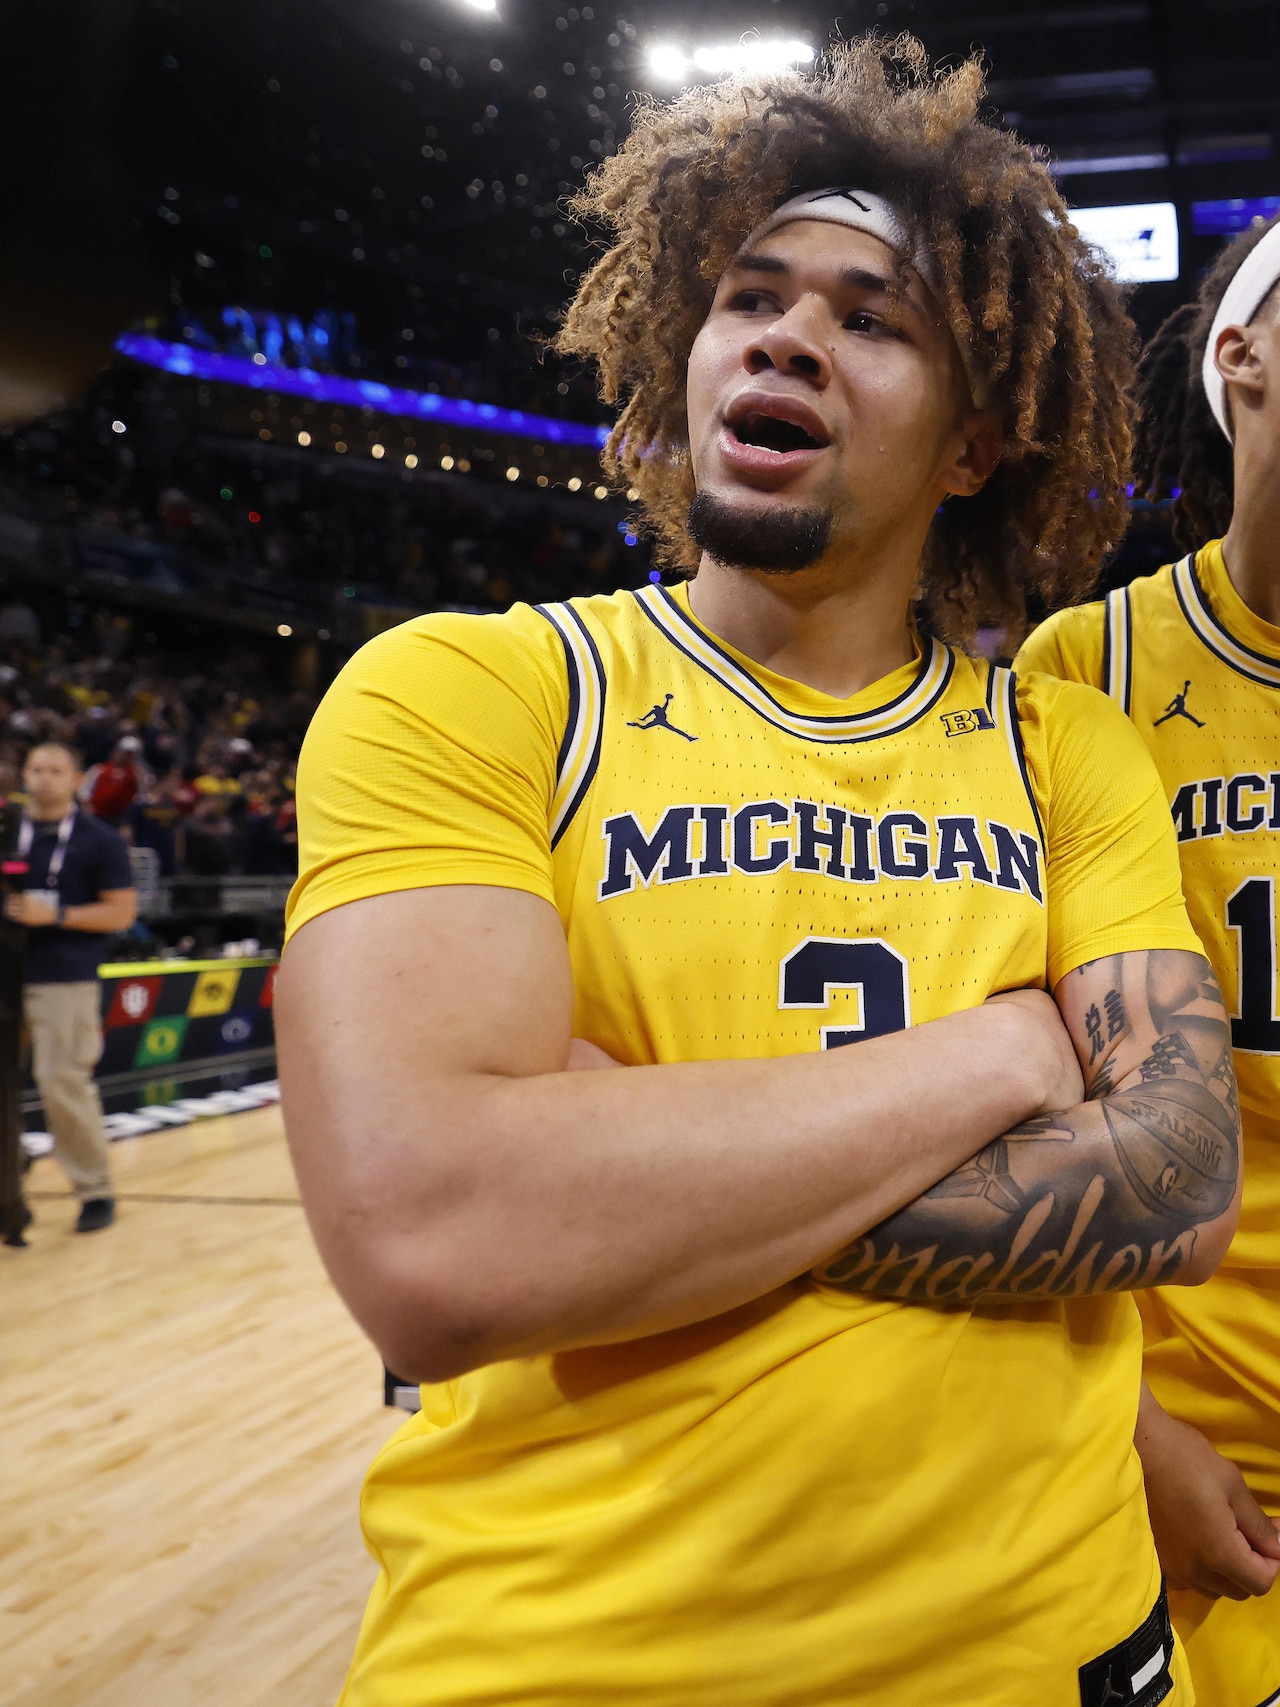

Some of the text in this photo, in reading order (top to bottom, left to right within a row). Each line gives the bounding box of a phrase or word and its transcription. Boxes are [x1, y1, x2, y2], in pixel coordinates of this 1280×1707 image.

[597, 800, 1046, 908] MICHIGAN
[777, 935, 912, 1051] 3
[811, 1174, 1199, 1299] onaldson
